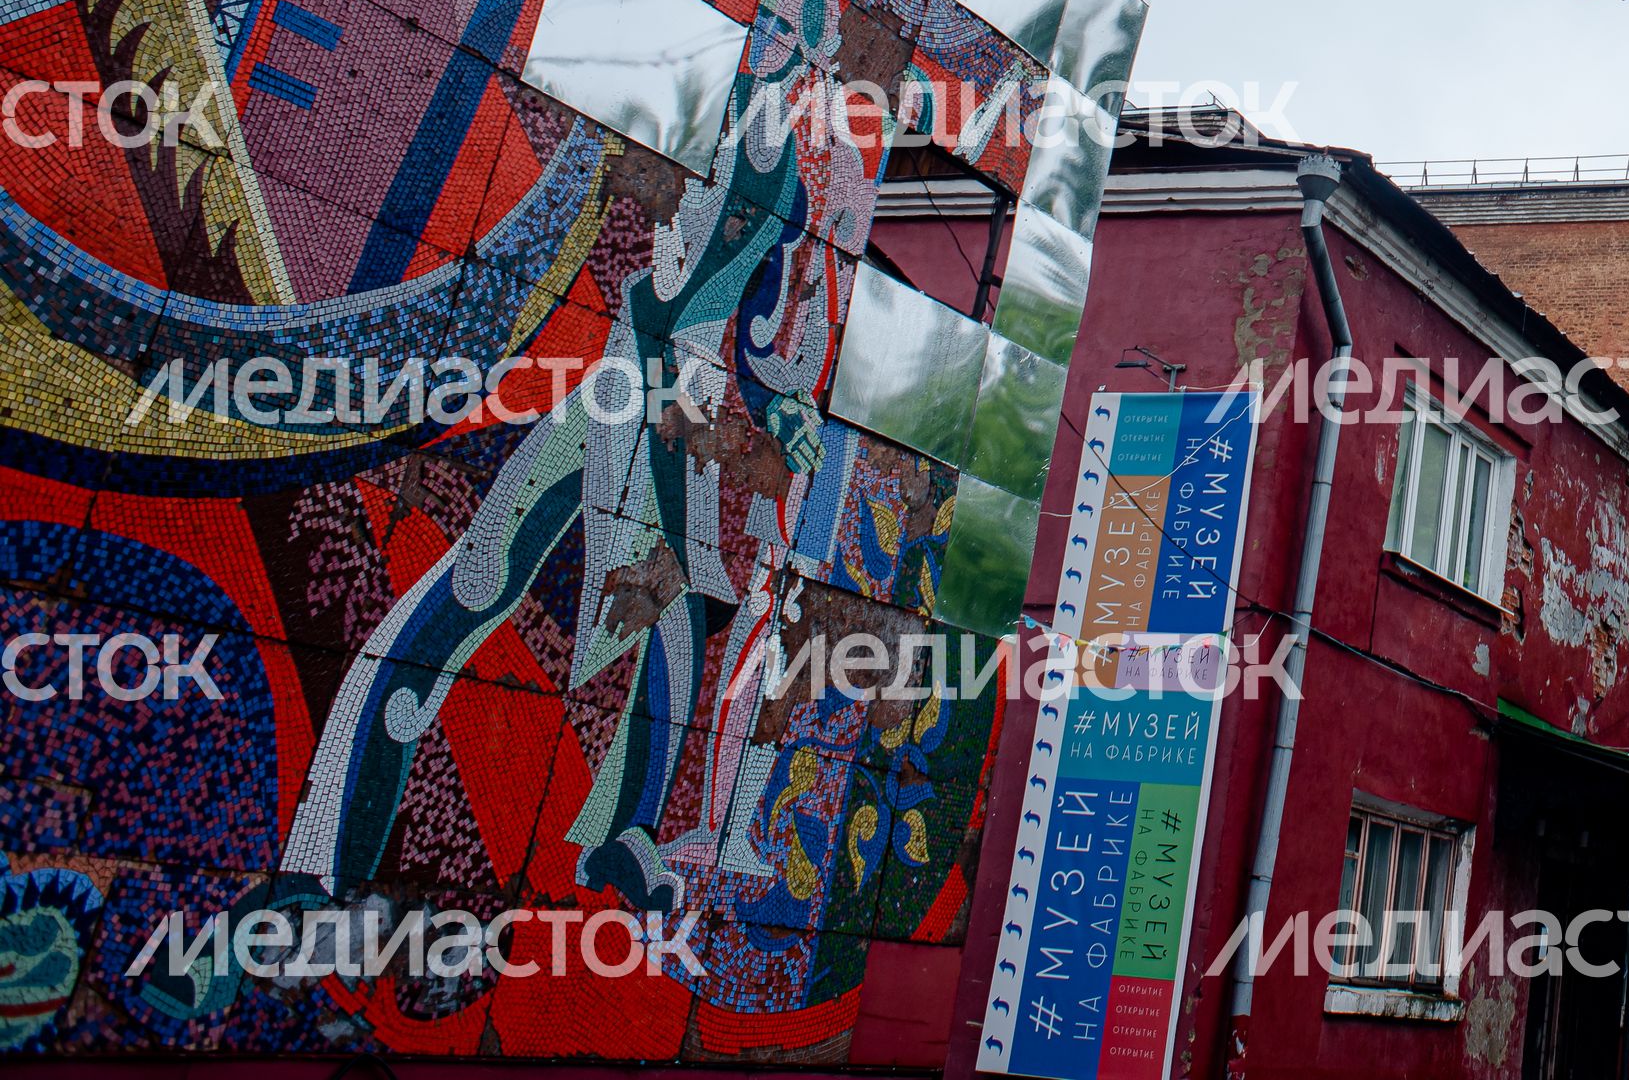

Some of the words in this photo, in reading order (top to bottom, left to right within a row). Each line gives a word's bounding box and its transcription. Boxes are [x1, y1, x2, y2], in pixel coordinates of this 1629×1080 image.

[1124, 415, 1169, 423] ОТКРЫТИЕ
[1121, 434, 1165, 442] ОТКРЫТИЕ
[1183, 437, 1203, 466] НА
[1117, 453, 1162, 461] ОТКРЫТИЕ
[1186, 436, 1234, 600] #МУЗЕЙ
[1133, 490, 1161, 589] ФАБРИКЕ
[1162, 482, 1194, 600] ФАБРИКЕ
[1126, 601, 1142, 627] НА
[1125, 666, 1141, 677] НА
[1150, 668, 1209, 681] ФАБРИКЕ
[1073, 710, 1200, 741] #МУЗЕЙ
[1070, 742, 1093, 759] НА
[1105, 745, 1197, 765] ФАБРИКЕ
[1138, 808, 1155, 836] НА
[1086, 791, 1133, 969] ФАБРИКЕ
[1141, 808, 1182, 962] #МУЗЕЙ
[1028, 790, 1099, 1040] #МУЗЕЙ
[1119, 850, 1148, 960] ФАБРИКЕ
[1119, 985, 1163, 997] ОТКРЫТИЕ
[1073, 995, 1103, 1041] НА
[1115, 1005, 1160, 1017] ОТКРЫТИЕ
[1112, 1025, 1158, 1038] ОТКРЫТИЕ
[1109, 1046, 1155, 1060] ОТКРЫТИЕ
